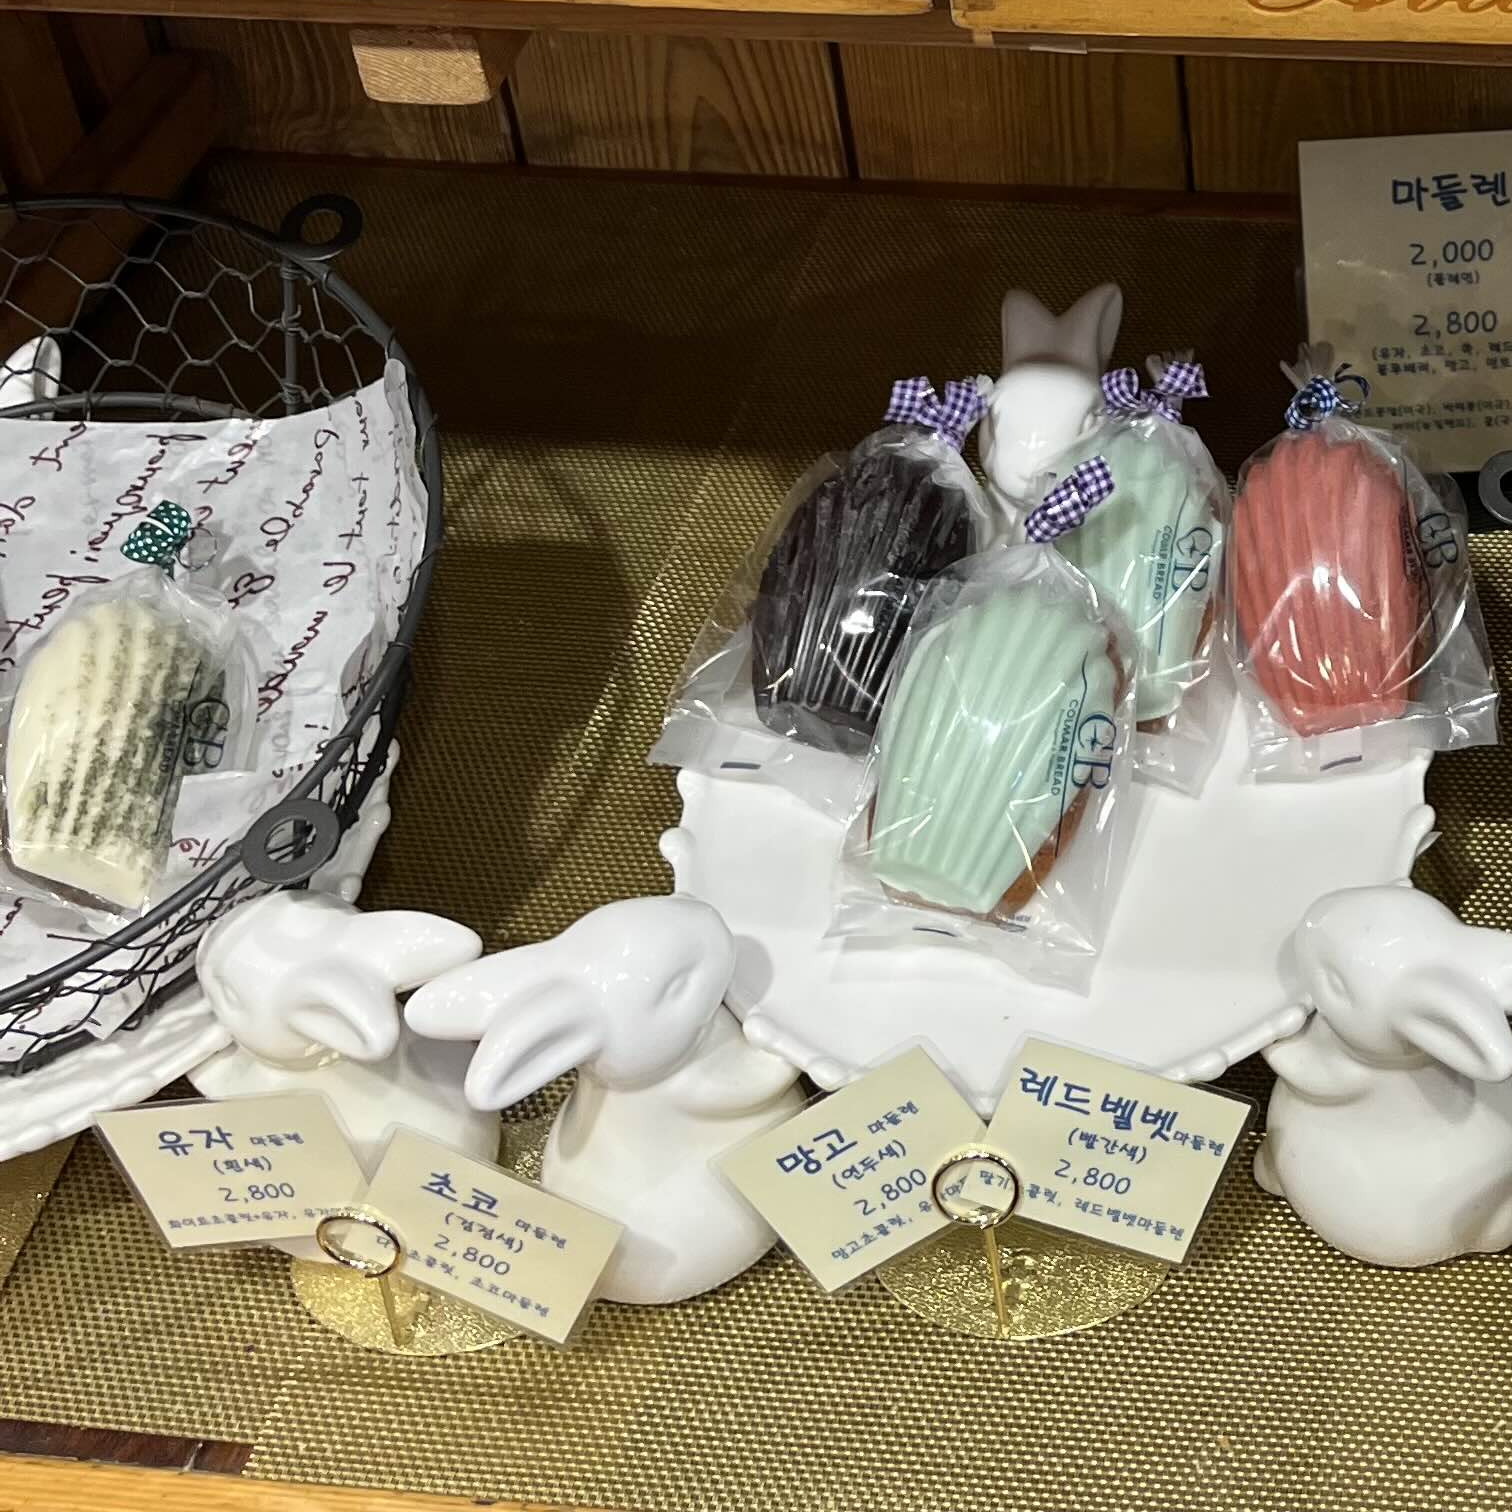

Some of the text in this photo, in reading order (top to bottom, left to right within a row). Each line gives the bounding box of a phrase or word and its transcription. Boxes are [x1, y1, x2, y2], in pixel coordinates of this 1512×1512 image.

[1392, 171, 1511, 211] 마들렌
[1410, 239, 1494, 269] 2,000
[1412, 309, 1498, 339] 2,800
[1020, 1067, 1226, 1157] 레드벨벳 마들렌
[158, 1125, 304, 1156] 유자 마들렌
[775, 1099, 919, 1174] 망고 마들렌
[1068, 1127, 1147, 1165] (빨간색)
[832, 1139, 907, 1190] (연두색)
[1053, 1158, 1132, 1196] 2,800
[218, 1182, 295, 1204] 2,800
[853, 1168, 927, 1216] 2,800
[978, 1168, 1062, 1208] 딸기콜릿,
[421, 1171, 567, 1249] 초코 마들렌
[433, 1233, 511, 1276] 2,800
